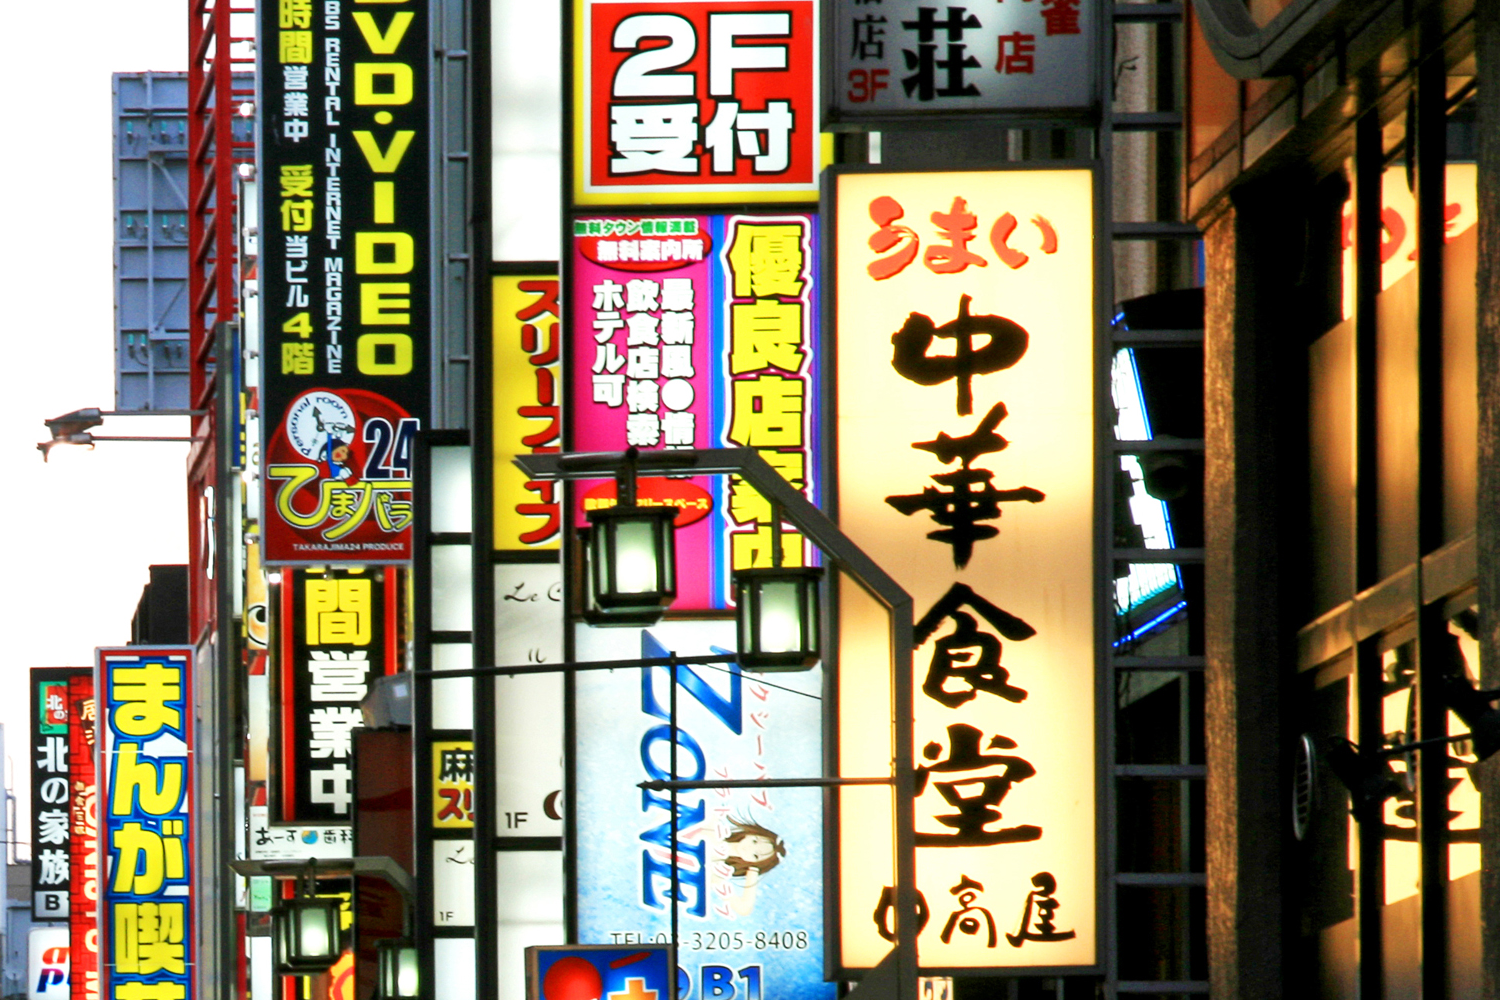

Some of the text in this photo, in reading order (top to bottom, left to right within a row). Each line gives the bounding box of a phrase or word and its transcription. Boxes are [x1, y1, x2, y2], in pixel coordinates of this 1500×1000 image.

[610, 11, 793, 99] 2F
[847, 68, 890, 103] 3F
[352, 0, 416, 376] VD・VIDEO
[608, 100, 794, 174] 受付
[278, 164, 315, 376] 受付当ビル4階
[324, 37, 343, 375] RENTAL INTERNET MAGAZINE
[866, 195, 1059, 281] うまい
[591, 278, 626, 408] ホテル可
[625, 278, 661, 447] 飲食店検索
[289, 396, 348, 457] Personal room
[885, 296, 1045, 849] 中華食堂
[304, 567, 372, 815] 間営業中
[505, 812, 529, 829] 1F
